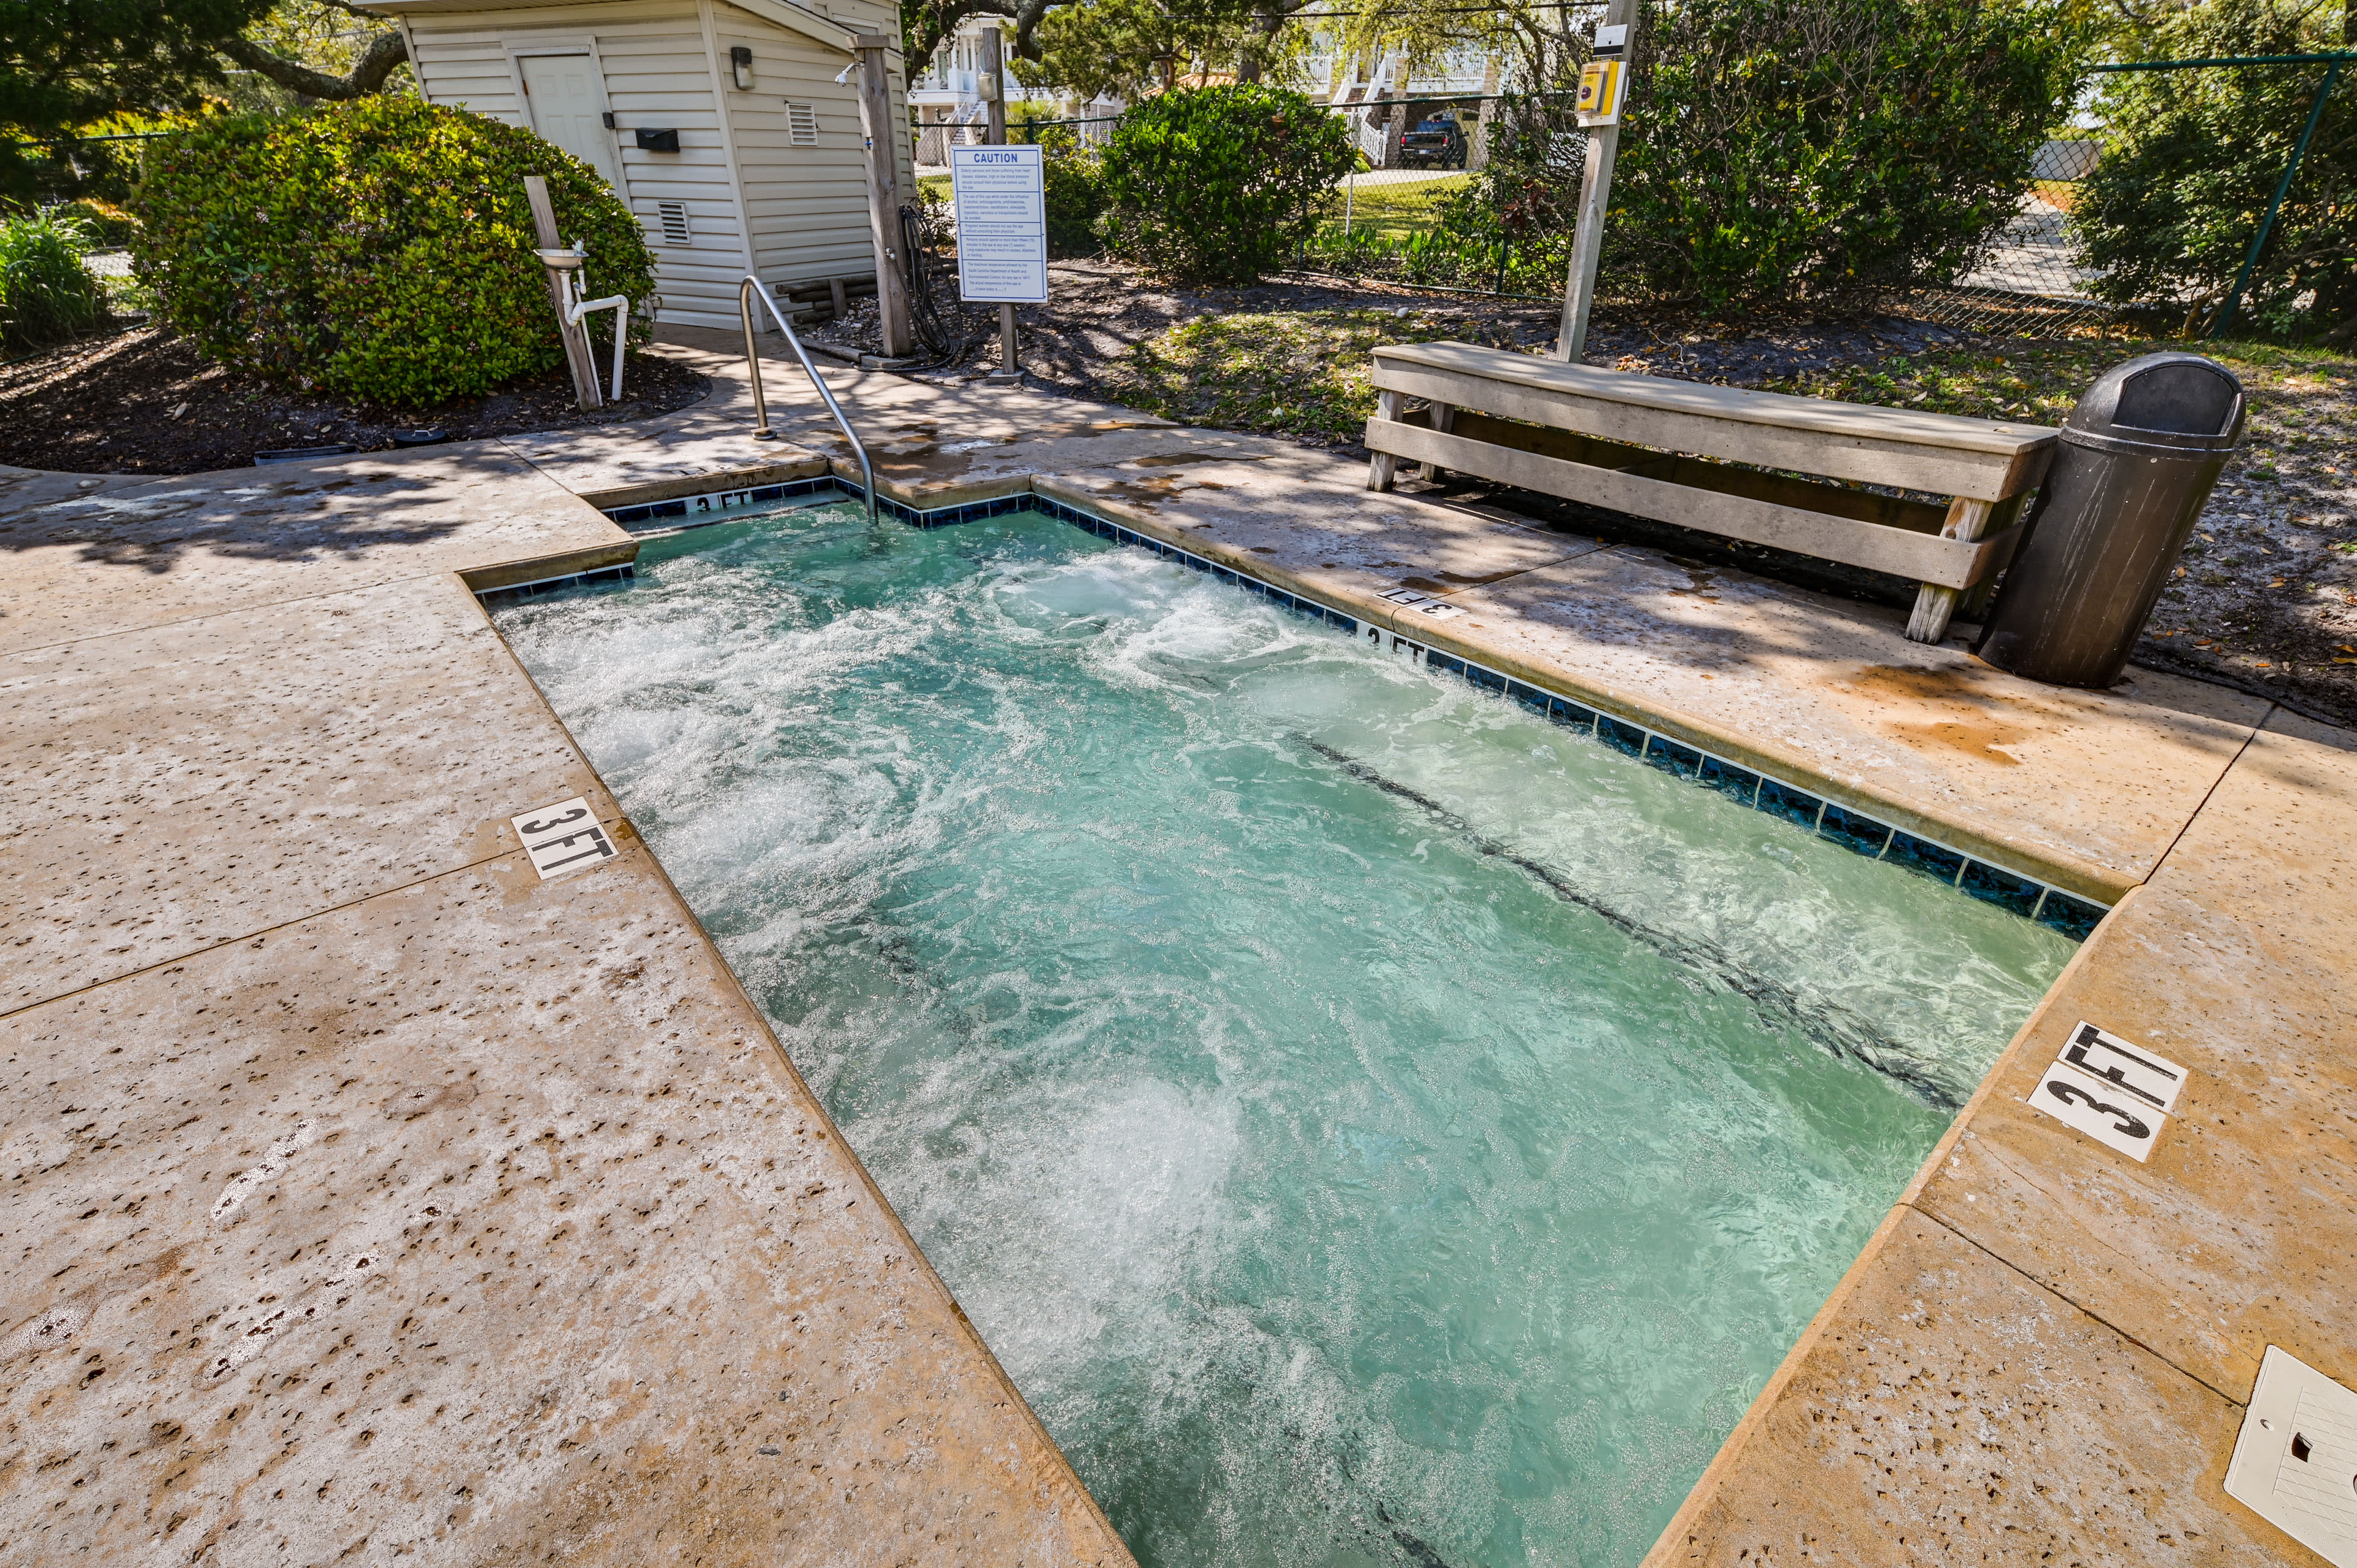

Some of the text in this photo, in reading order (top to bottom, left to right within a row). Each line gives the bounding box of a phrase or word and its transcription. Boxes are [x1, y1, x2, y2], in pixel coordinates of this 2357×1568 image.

[974, 153, 1018, 163] CAUTION
[721, 491, 748, 508] FT
[1376, 590, 1453, 617] 3 FT
[521, 808, 614, 871] 3 FT
[2046, 1024, 2178, 1139] 3 FT
